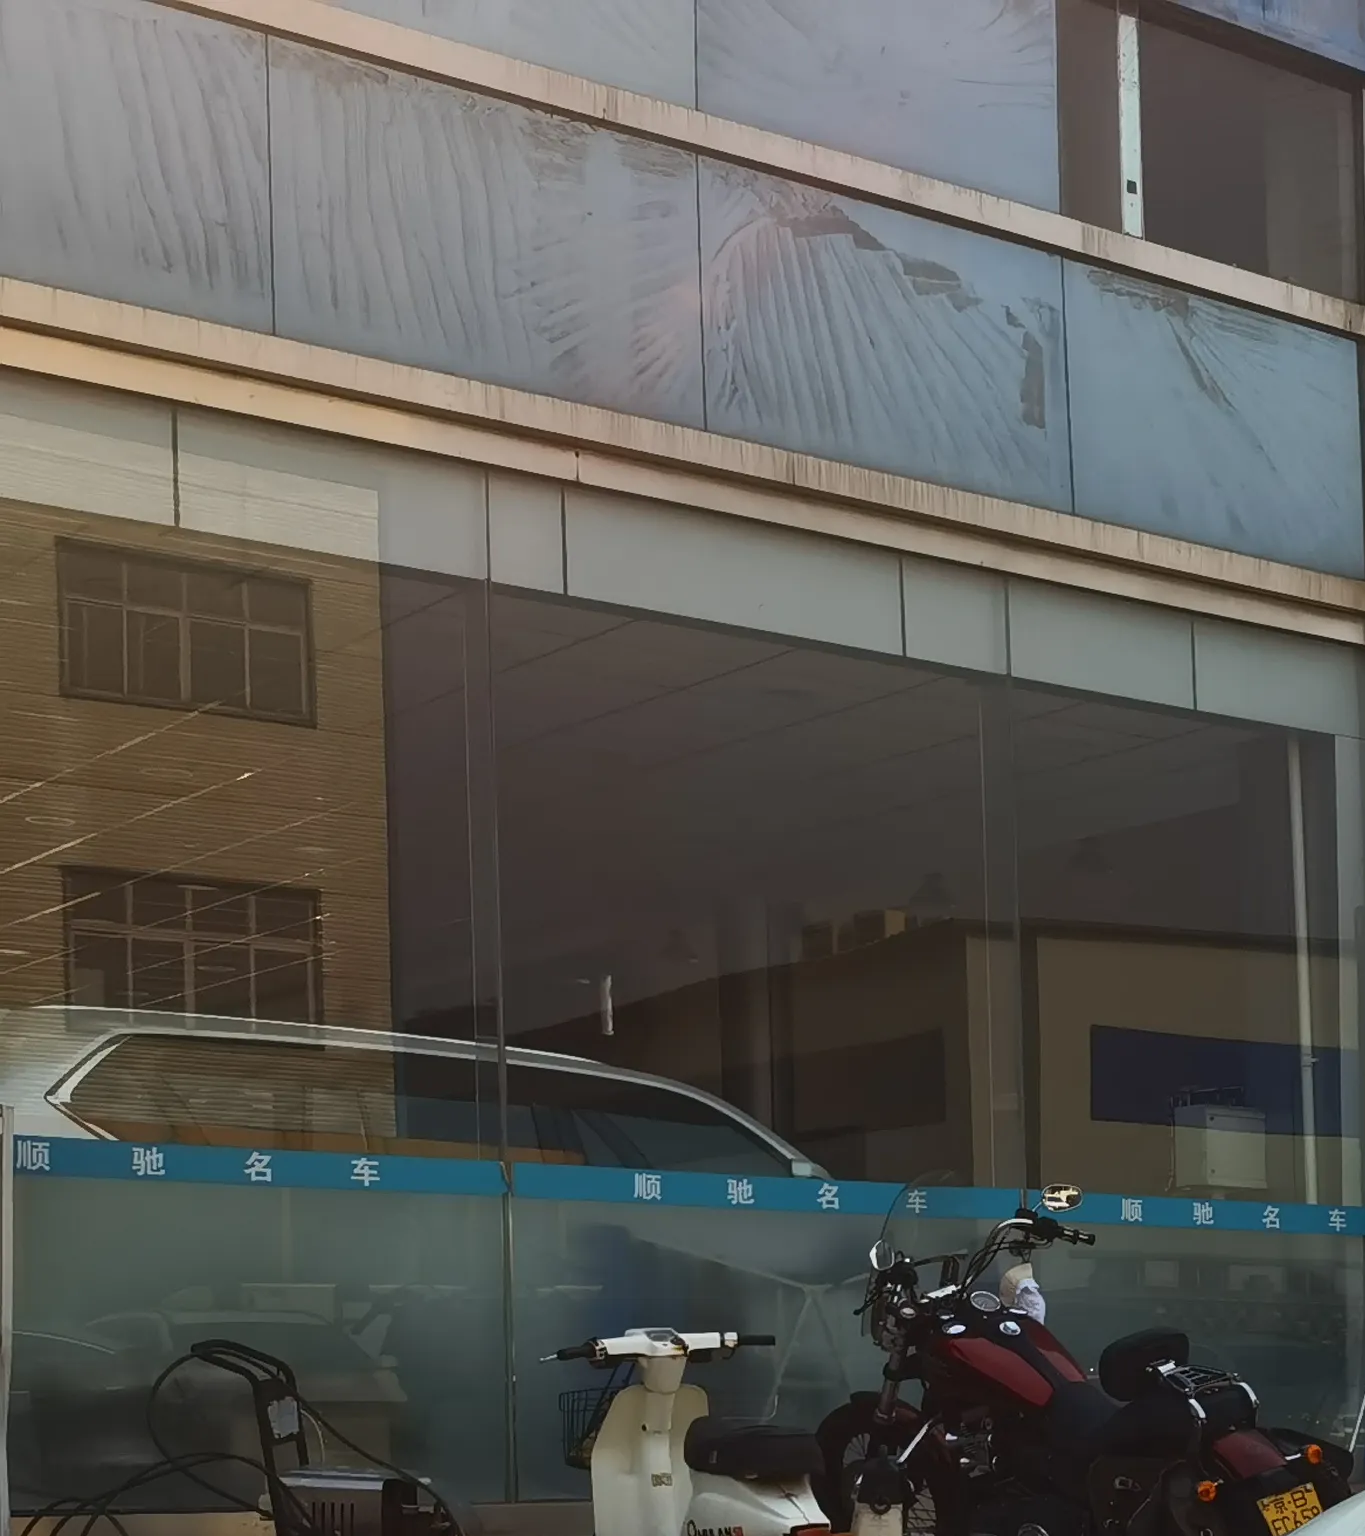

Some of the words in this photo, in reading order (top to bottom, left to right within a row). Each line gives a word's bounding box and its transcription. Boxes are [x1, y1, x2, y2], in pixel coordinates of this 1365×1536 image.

[16, 1139, 381, 1187] 顺驰名车
[633, 1173, 928, 1214] 顺驰名车
[1120, 1198, 1347, 1232] 顺驰名车
